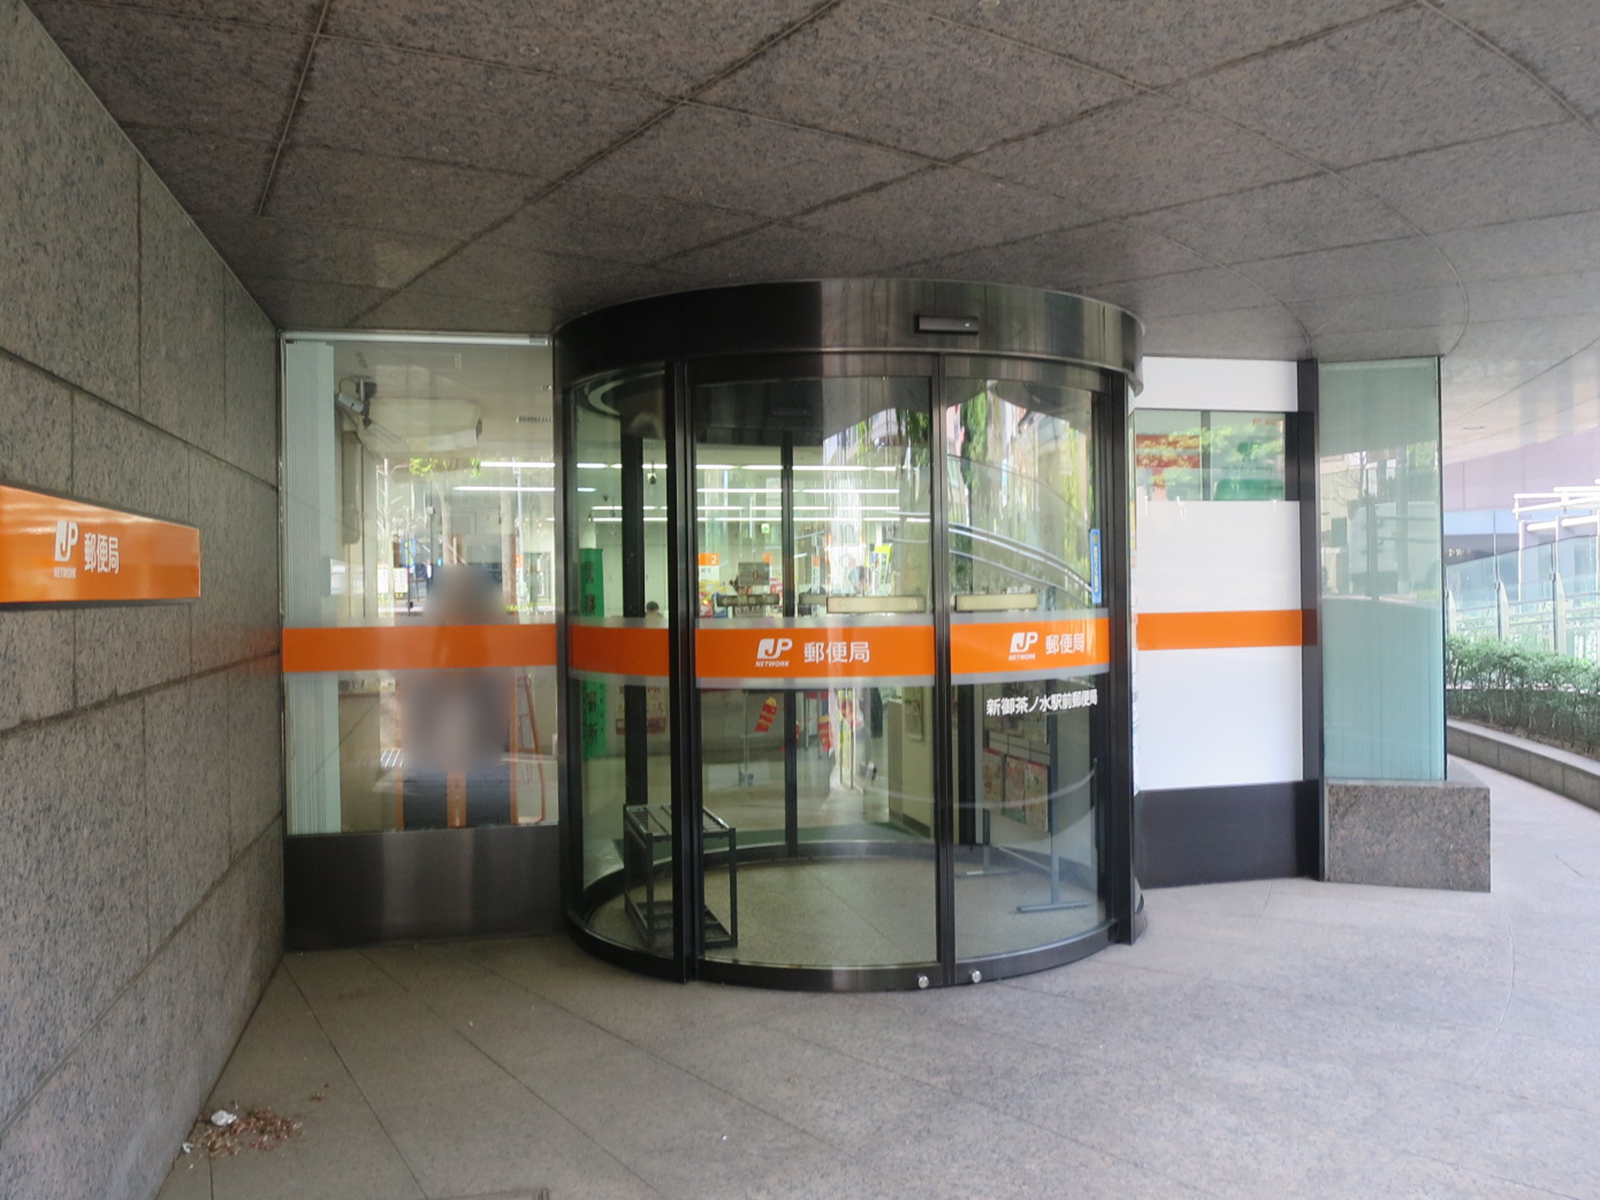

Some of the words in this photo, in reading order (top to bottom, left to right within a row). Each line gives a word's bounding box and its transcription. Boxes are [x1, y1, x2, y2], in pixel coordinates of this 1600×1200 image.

[85, 533, 118, 573] 郵便局
[54, 568, 76, 578] NETWORK
[757, 638, 792, 659] JP
[804, 641, 870, 663] 郵便局
[1011, 632, 1038, 652] JP
[1046, 634, 1084, 654] 郵便局
[1009, 653, 1036, 661] NETWORK
[986, 689, 1098, 716] 新御茶ノ水駅前郵便局
